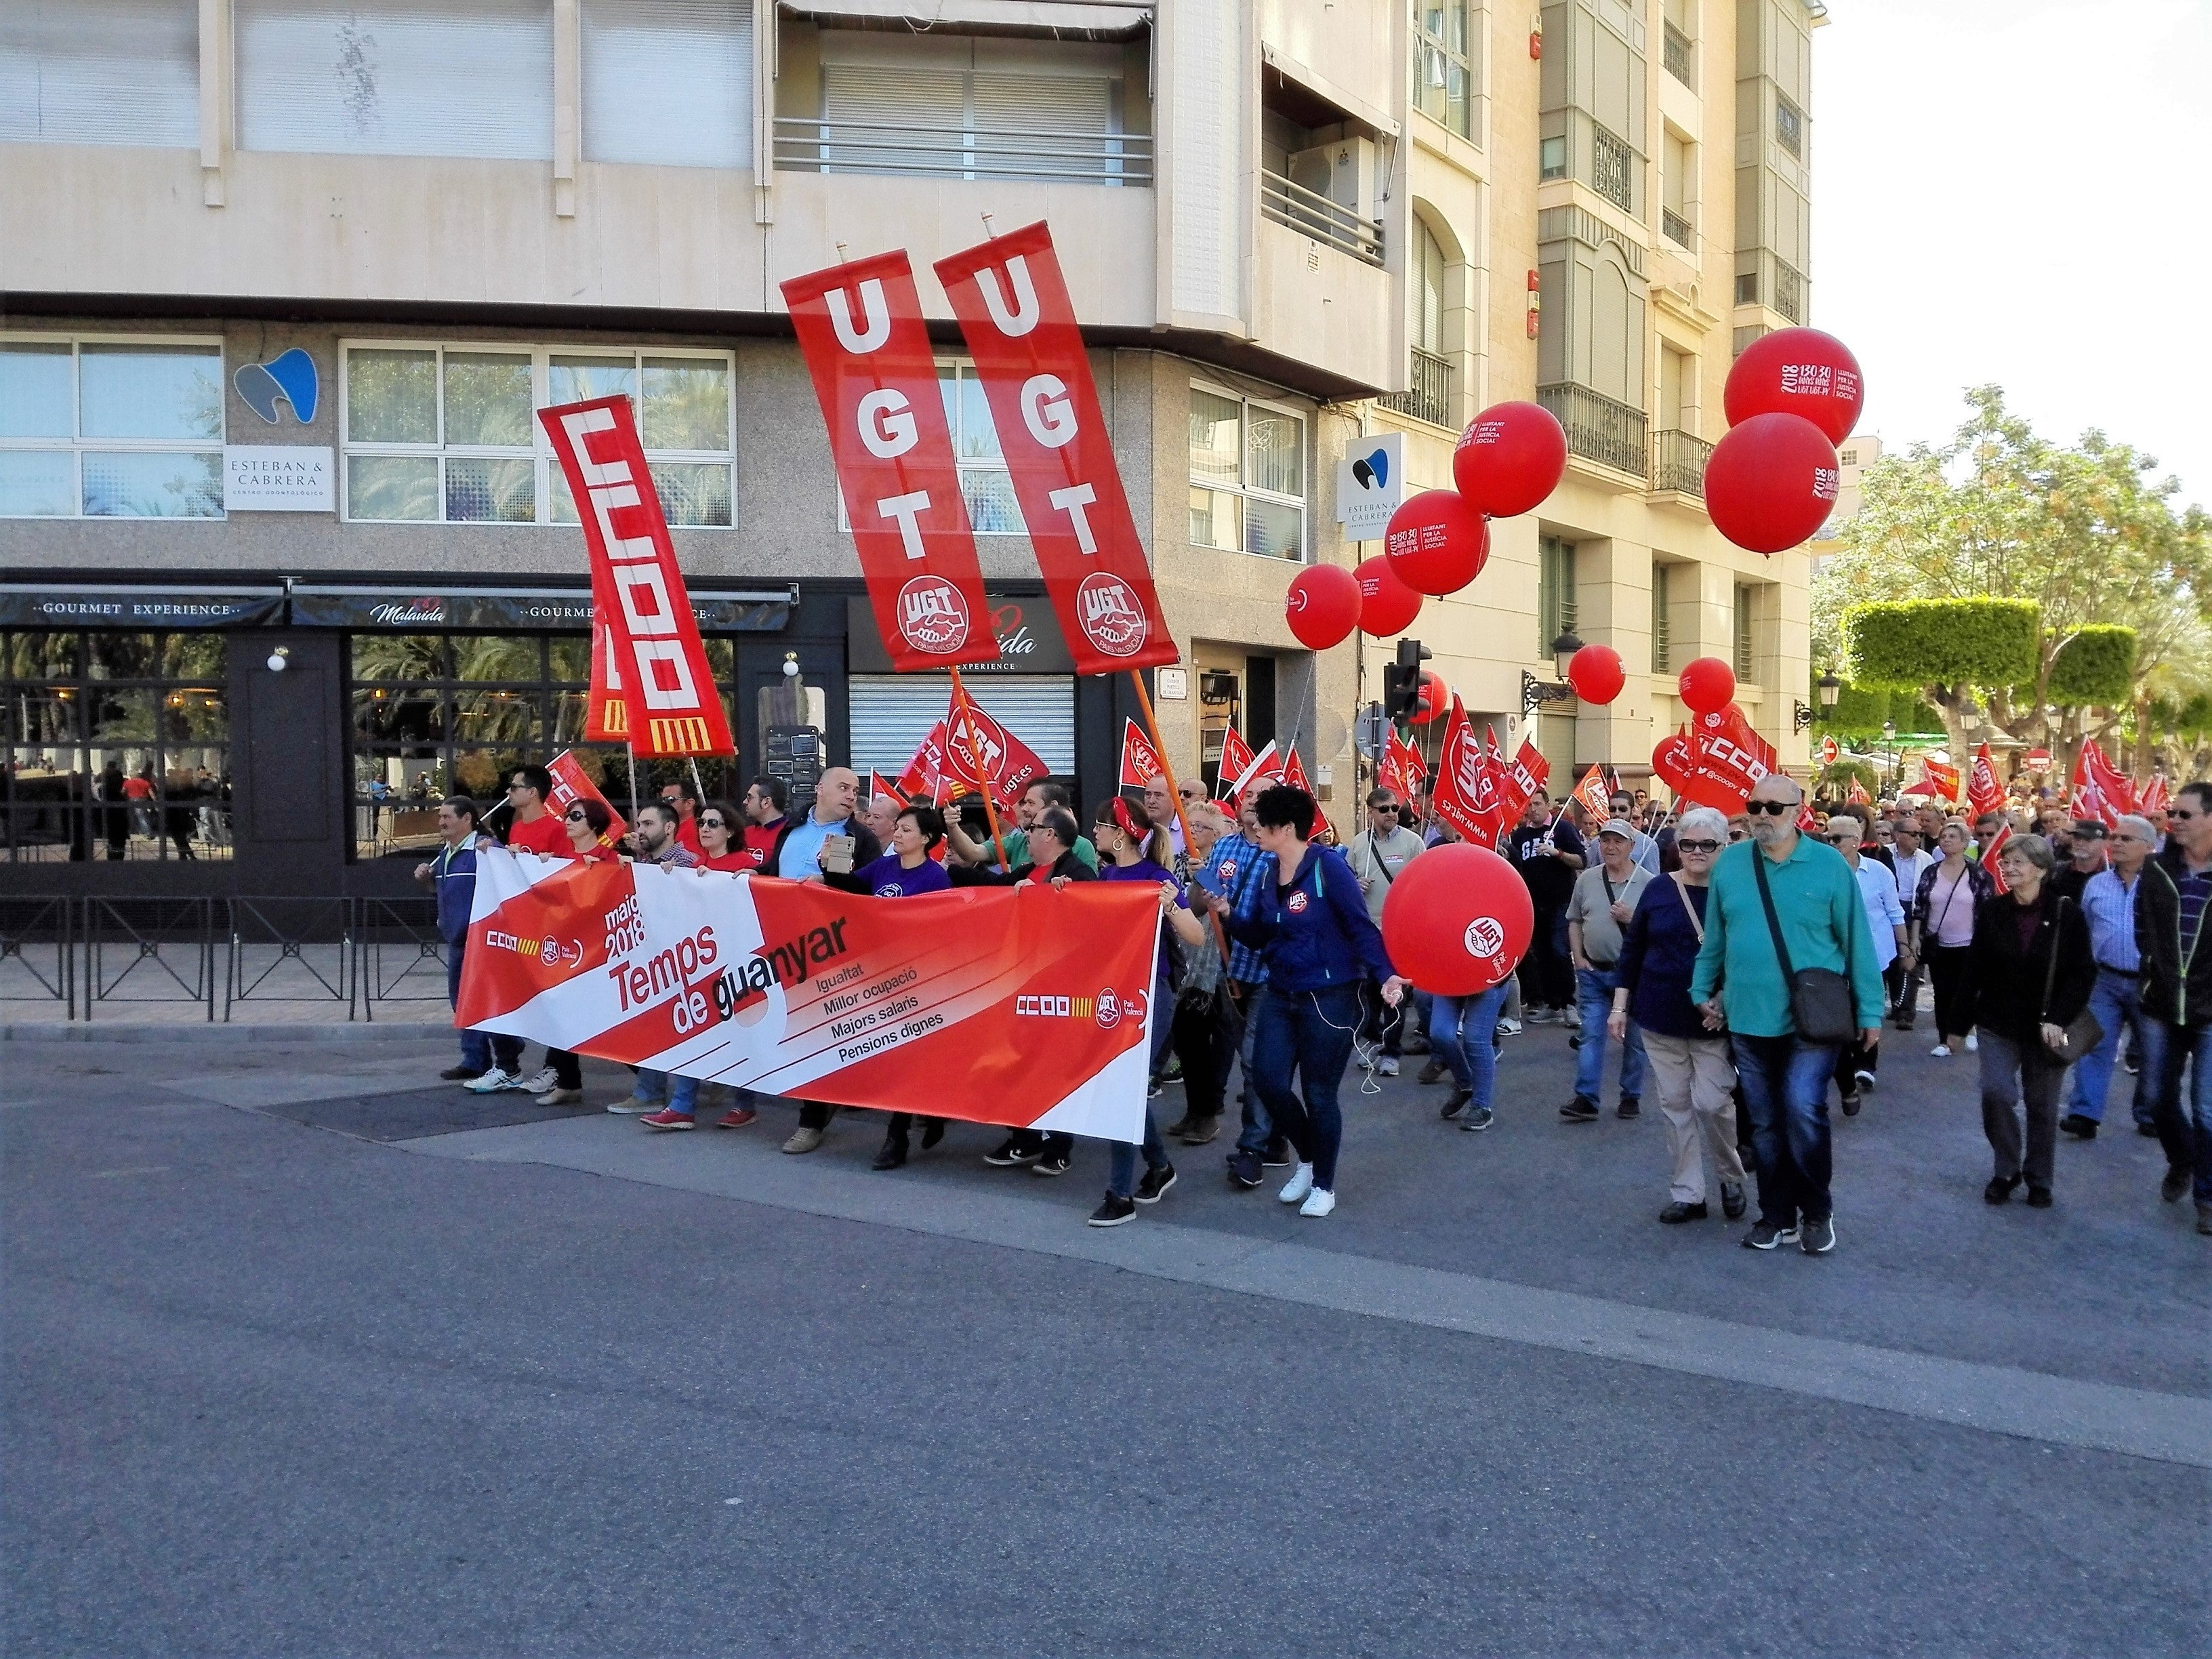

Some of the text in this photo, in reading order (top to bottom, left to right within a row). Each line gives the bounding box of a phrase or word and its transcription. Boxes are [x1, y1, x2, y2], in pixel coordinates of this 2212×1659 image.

[1781, 365, 1799, 393] 2018
[1800, 365, 1831, 379] 130 30
[823, 278, 930, 560] UGT
[973, 255, 1097, 554] UGT
[232, 461, 323, 472] ESTEBAN &
[238, 475, 316, 485] CABRERA
[1812, 467, 1827, 498] 2018
[1349, 503, 1388, 513] ESTEBAN
[1352, 511, 1393, 521] CABRERA
[1408, 529, 1417, 539] 30
[1423, 524, 1446, 532] LLUITANT
[560, 407, 700, 710] CCOO
[43, 603, 230, 615] GOURMET EXPERIENCE
[369, 603, 445, 623] Malavida
[529, 607, 594, 617] GOURME
[905, 586, 959, 620] UGT
[1084, 585, 1126, 618] UGT
[1708, 736, 1770, 784] CCO
[1706, 770, 1738, 790] @ccoopv
[1441, 799, 1488, 842] www.ugt.es
[605, 893, 640, 931] maig
[486, 930, 518, 951] CCOO
[544, 941, 556, 953] UGT
[605, 917, 647, 958] 2018
[1476, 920, 1501, 949] UGT
[609, 925, 718, 1012] Temps
[672, 916, 847, 1034] de guanyar
[816, 963, 864, 994] Igualtat
[823, 966, 918, 1015] Millor ocupació
[1099, 995, 1115, 1010] UGT
[831, 996, 918, 1038] Majors salaris
[1016, 996, 1070, 1017] CCOO
[838, 1013, 943, 1062] Pensions dignes
